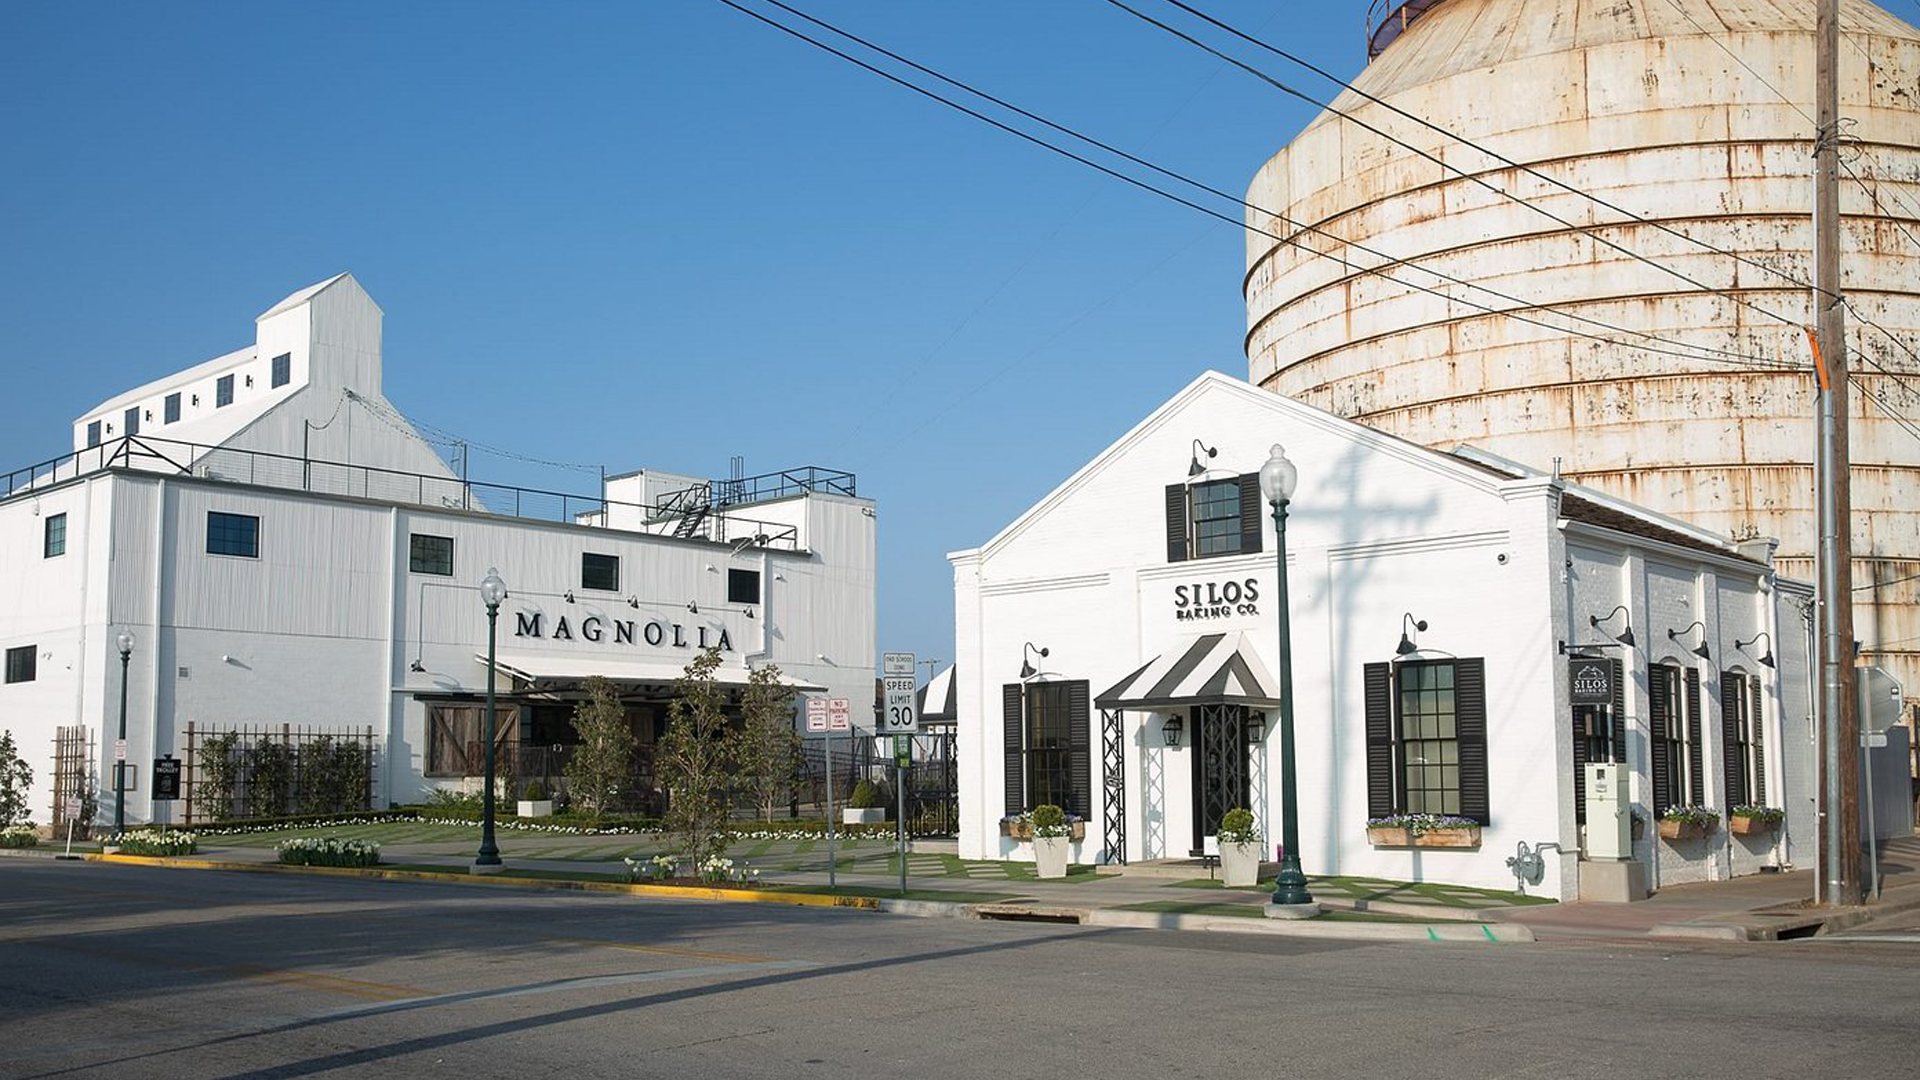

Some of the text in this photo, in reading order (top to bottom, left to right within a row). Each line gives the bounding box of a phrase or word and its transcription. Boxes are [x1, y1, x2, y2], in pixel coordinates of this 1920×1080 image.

[1175, 578, 1259, 608] SILOS
[1177, 606, 1231, 620] BAKING
[515, 613, 733, 651] MAGNOLIA
[886, 681, 914, 691] SPEED
[1574, 680, 1608, 689] SILOS
[890, 695, 911, 704] LIMIT
[890, 706, 912, 726] 30
